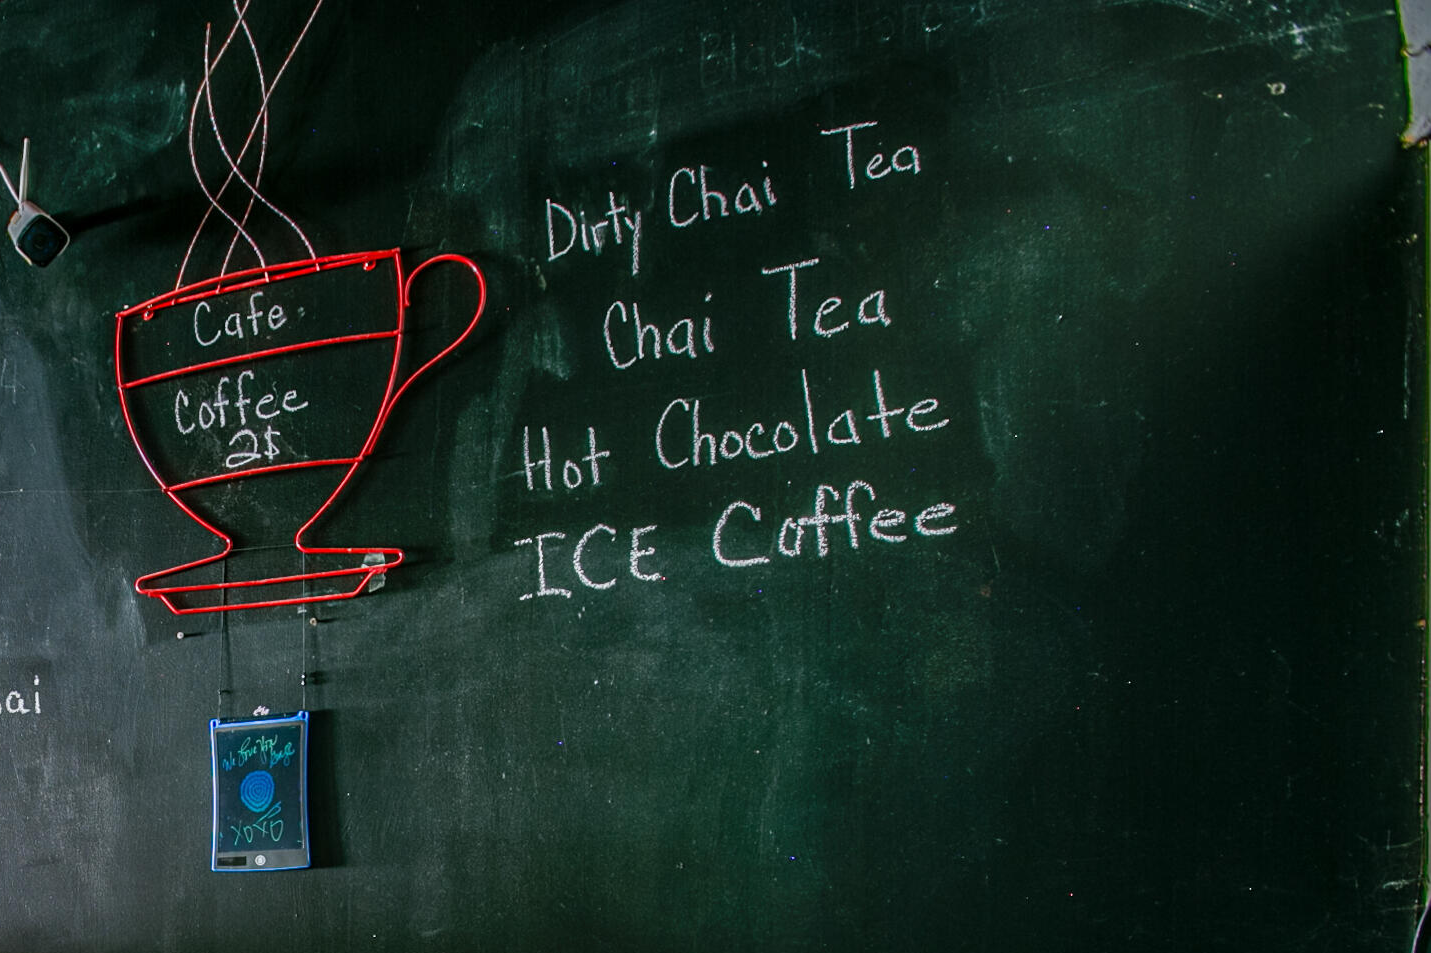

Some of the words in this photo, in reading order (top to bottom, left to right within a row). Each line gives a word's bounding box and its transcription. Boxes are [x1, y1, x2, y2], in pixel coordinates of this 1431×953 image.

[546, 192, 642, 276] Dirty
[669, 160, 778, 227] Chai
[820, 121, 922, 190] Tea
[193, 291, 288, 347] Cafe
[603, 292, 715, 370] Chai
[761, 258, 892, 341] Tea
[174, 370, 309, 435] Coffee
[225, 427, 282, 468] 2$
[523, 425, 610, 491] Hot
[655, 368, 950, 470] Chocolate
[513, 523, 663, 602] ICE
[711, 480, 958, 568] Coffee
